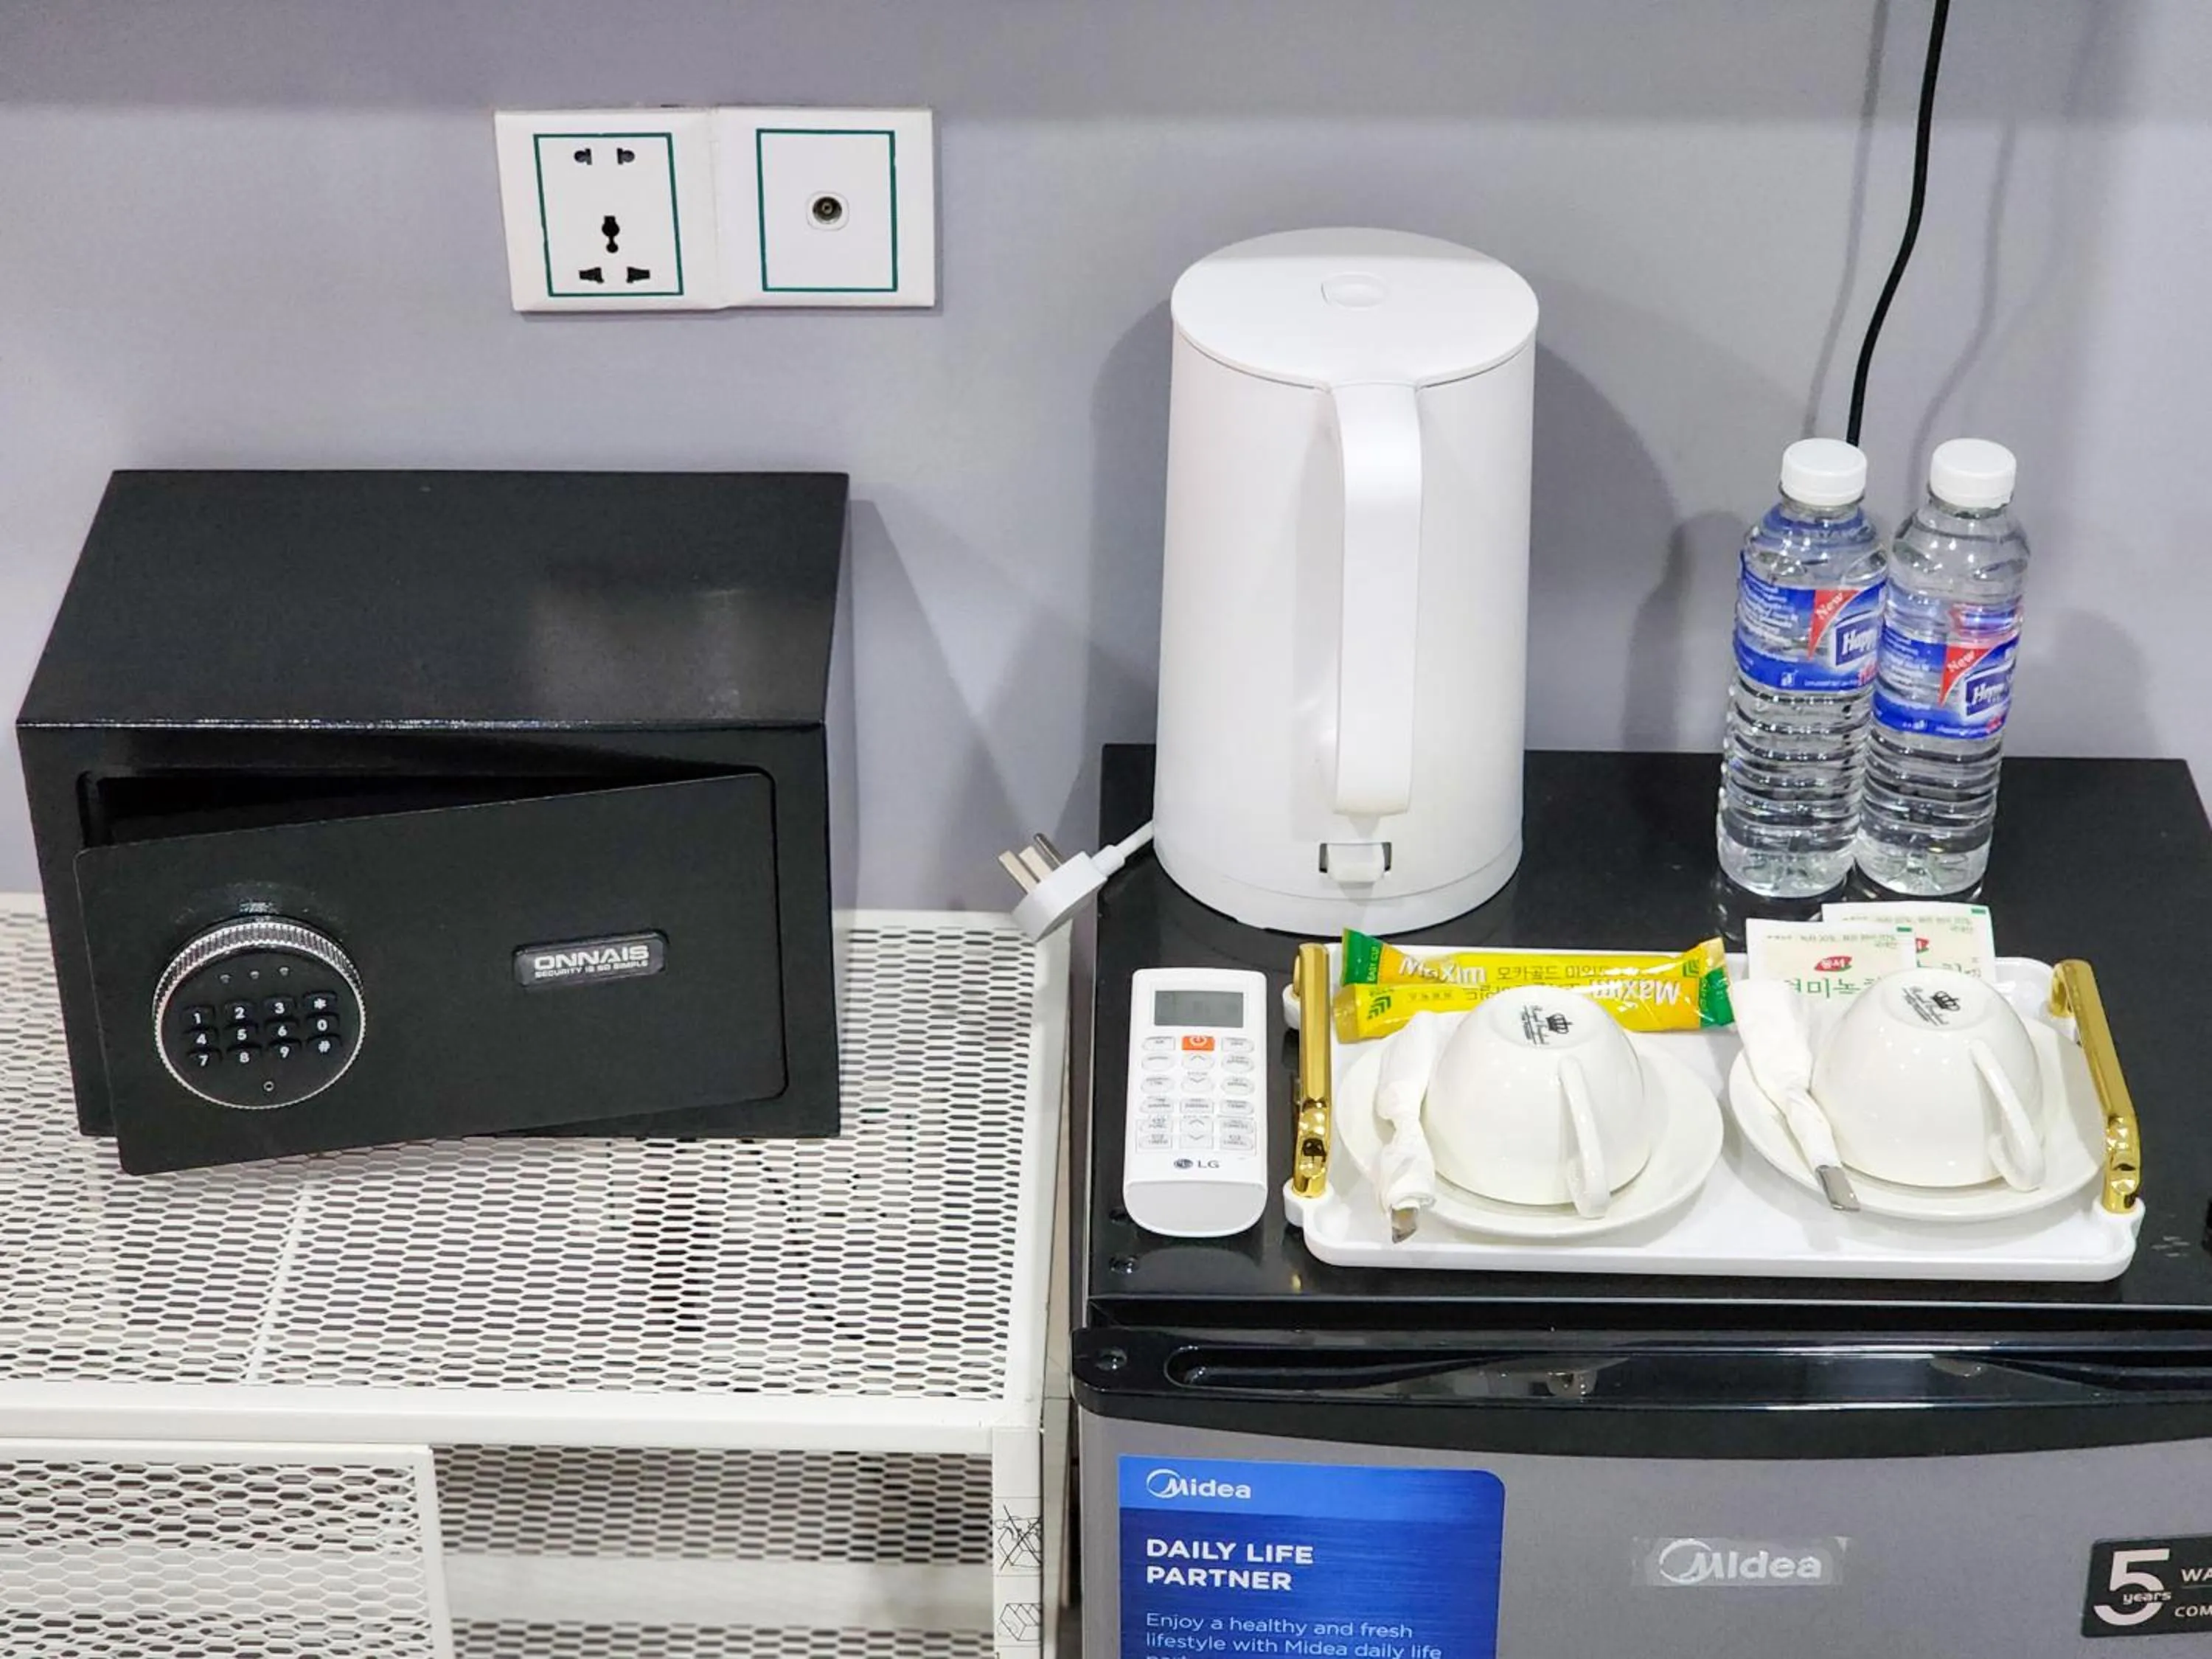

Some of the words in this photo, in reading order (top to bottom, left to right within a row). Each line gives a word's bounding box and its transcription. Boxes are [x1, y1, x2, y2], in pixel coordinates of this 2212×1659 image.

[1815, 592, 1843, 619] New
[1947, 650, 1975, 672] New
[535, 945, 649, 970] ONNAIS
[535, 967, 583, 978] SECURITY
[585, 965, 594, 973] IS
[613, 960, 648, 970] SIMPLE
[1398, 956, 1487, 984] Maxim
[1590, 979, 1681, 1006] Maxim
[194, 1012, 201, 1024] 1
[234, 1006, 245, 1019] 2
[274, 1001, 285, 1014] 3
[196, 1034, 207, 1045] 4
[237, 1029, 247, 1040] 5
[277, 1026, 288, 1037] 6
[316, 1019, 327, 1031] 0
[198, 1054, 209, 1067] 7
[239, 1051, 250, 1063] 8
[279, 1046, 290, 1059] 9
[318, 1040, 331, 1053] #
[1197, 1159, 1220, 1169] LG
[1147, 1469, 1251, 1499] Midea
[1147, 1539, 1237, 1561] DAILY
[1247, 1543, 1314, 1565] LIFE
[1659, 1538, 1822, 1585] Midea
[1147, 1565, 1293, 1591] PARTNER
[2093, 1548, 2170, 1626] 5
[2122, 1591, 2171, 1605] years
[1147, 1613, 1204, 1633] Enjoy
[1211, 1618, 1223, 1630] a
[1230, 1616, 1307, 1636] healthy
[1314, 1621, 1353, 1635] and
[1360, 1622, 1413, 1639] fresh
[1147, 1632, 1226, 1652] lifestyle
[1233, 1638, 1278, 1653] with
[1285, 1639, 1348, 1657] Midea
[1354, 1643, 1405, 1659] daily
[1411, 1644, 1442, 1659] life
